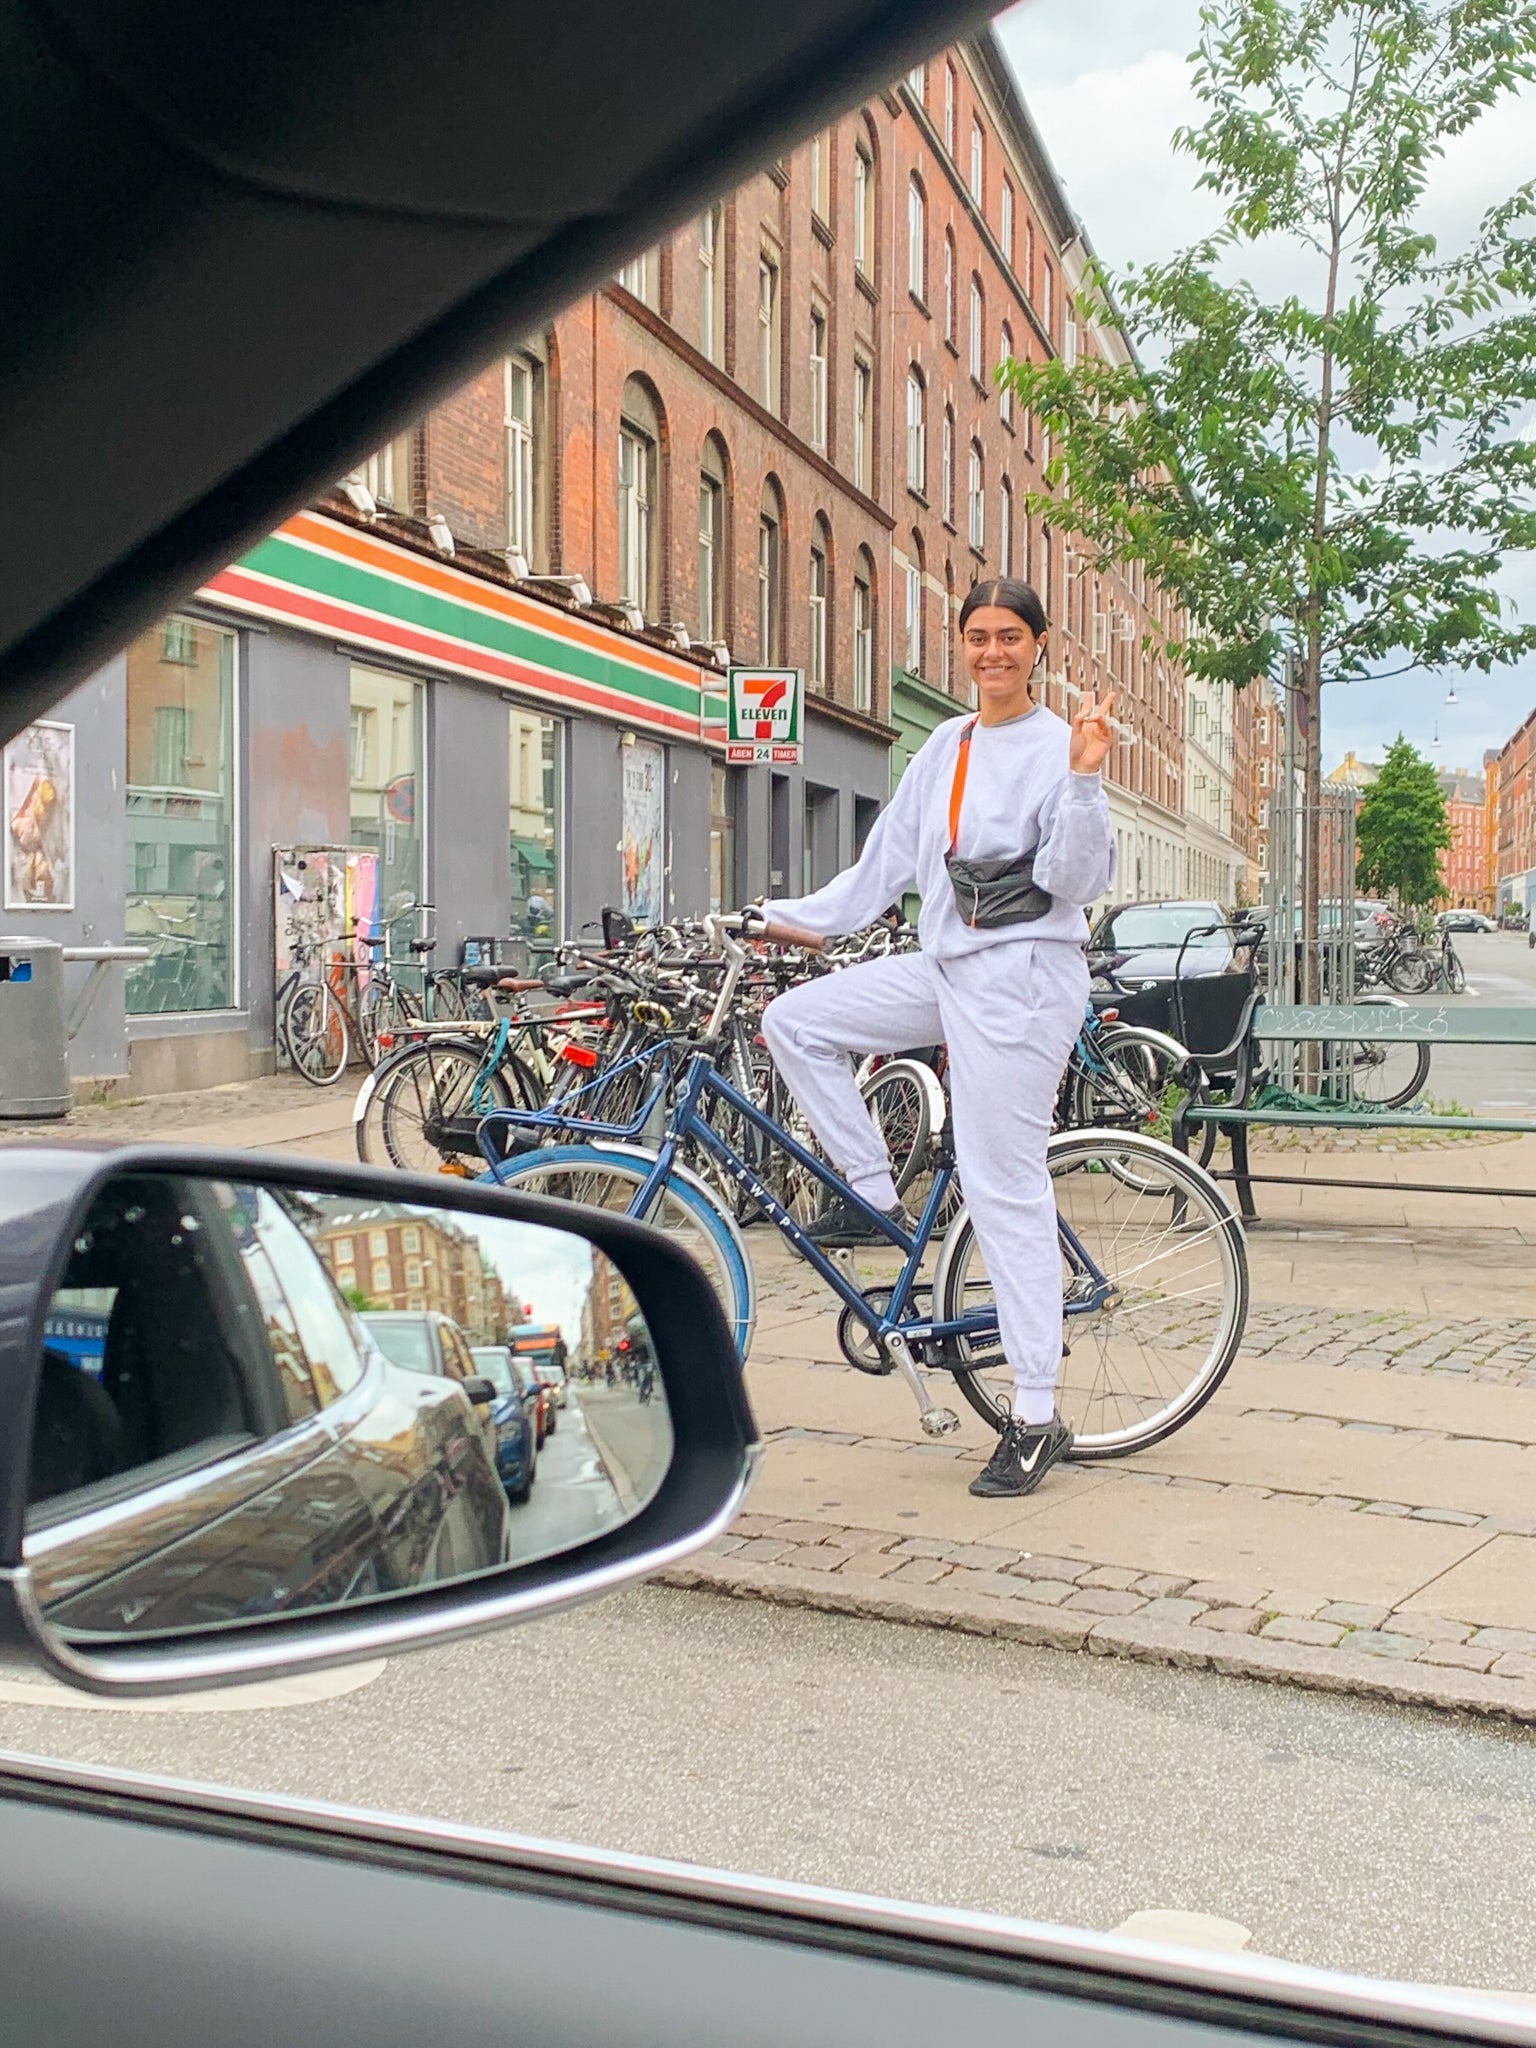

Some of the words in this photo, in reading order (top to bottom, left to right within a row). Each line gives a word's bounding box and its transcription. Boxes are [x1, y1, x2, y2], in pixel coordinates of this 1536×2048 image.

[743, 679, 787, 739] 7
[756, 748, 770, 760] 24
[773, 750, 797, 759] TIMER
[736, 1169, 791, 1227] SWAP
